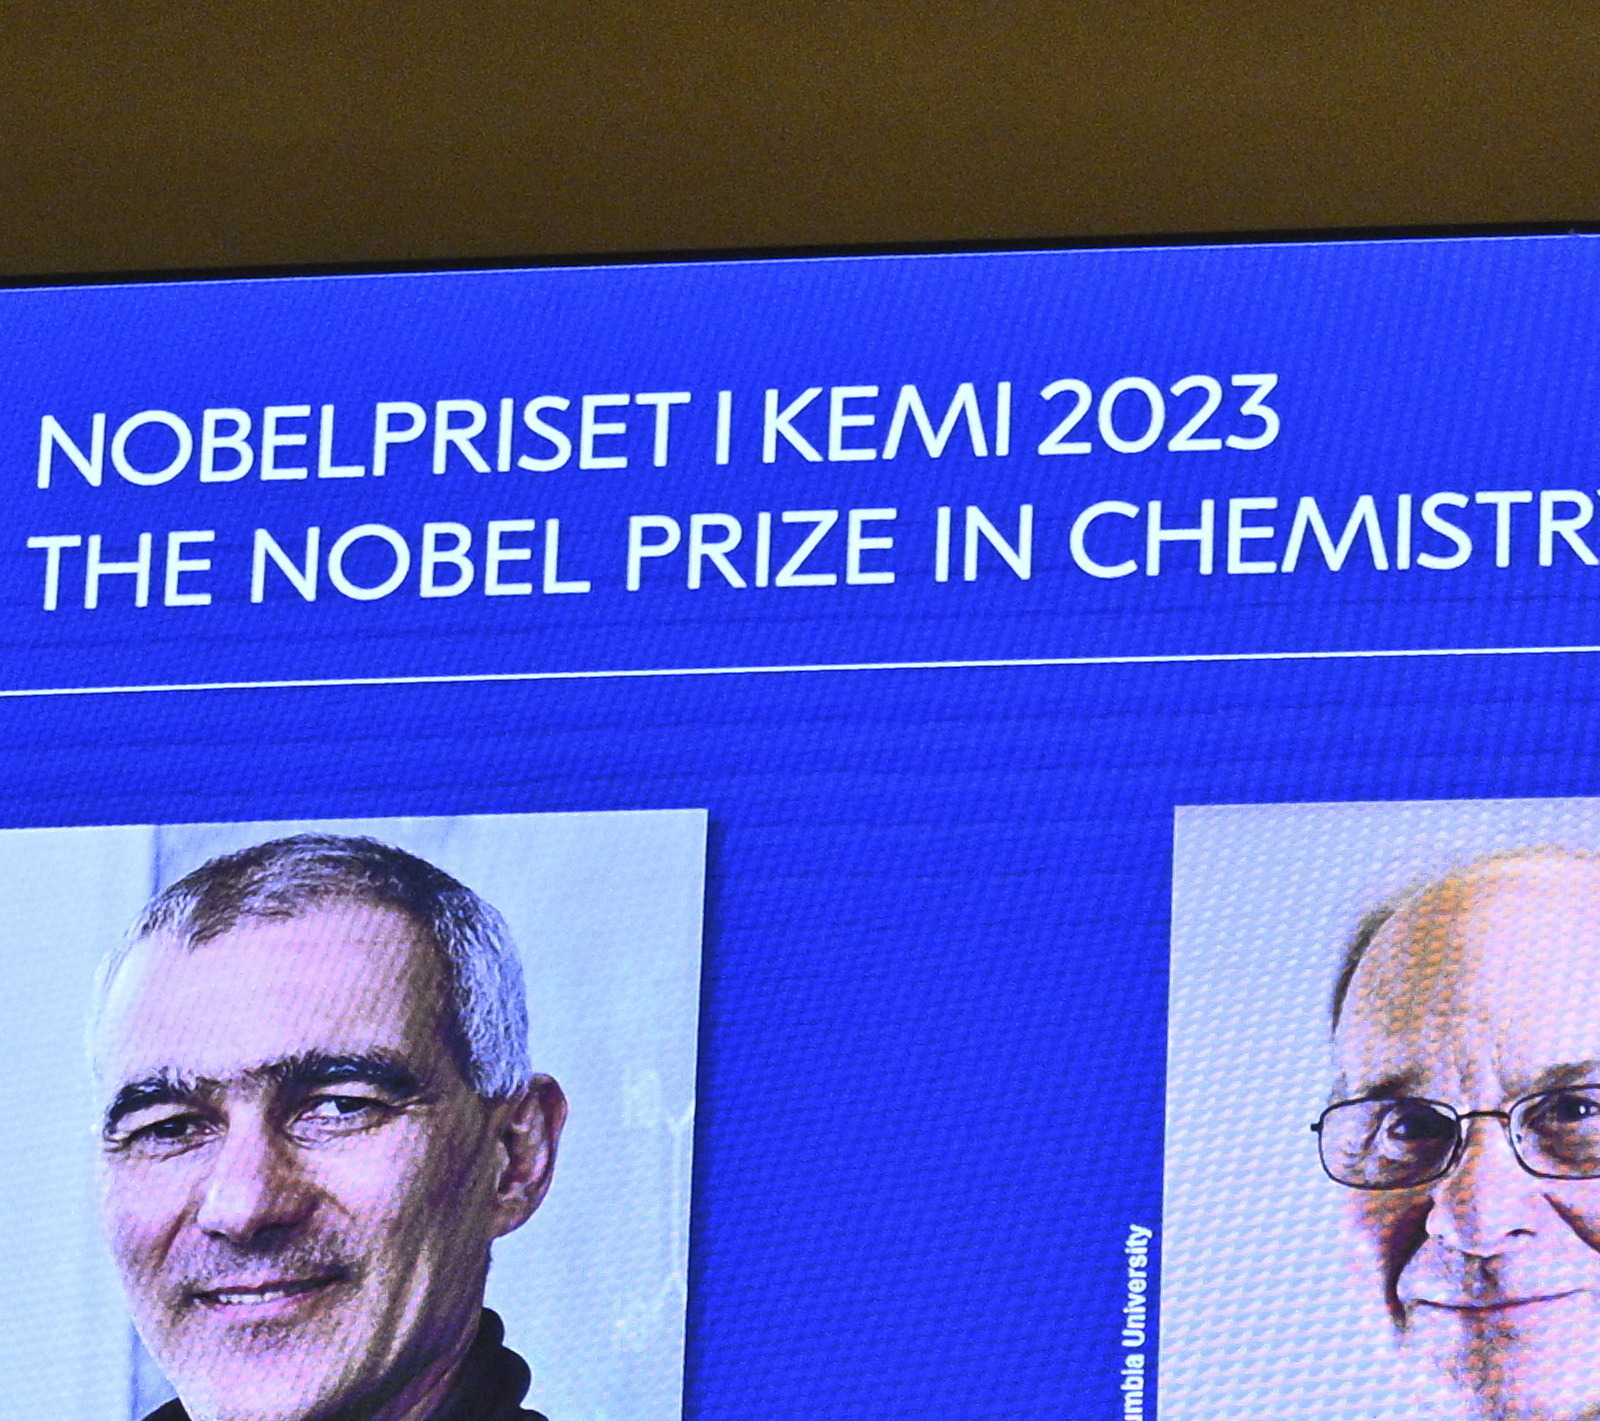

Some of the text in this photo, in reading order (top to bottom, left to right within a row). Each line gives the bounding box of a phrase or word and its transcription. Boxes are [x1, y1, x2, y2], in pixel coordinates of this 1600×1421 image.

[38, 374, 1279, 488] NOBELPRISET I KEMI 2023
[27, 531, 214, 610] THE
[251, 519, 590, 603] NOBEL
[627, 508, 896, 591] PRIZE
[936, 505, 1032, 581] IN
[1122, 1225, 1152, 1346] University
